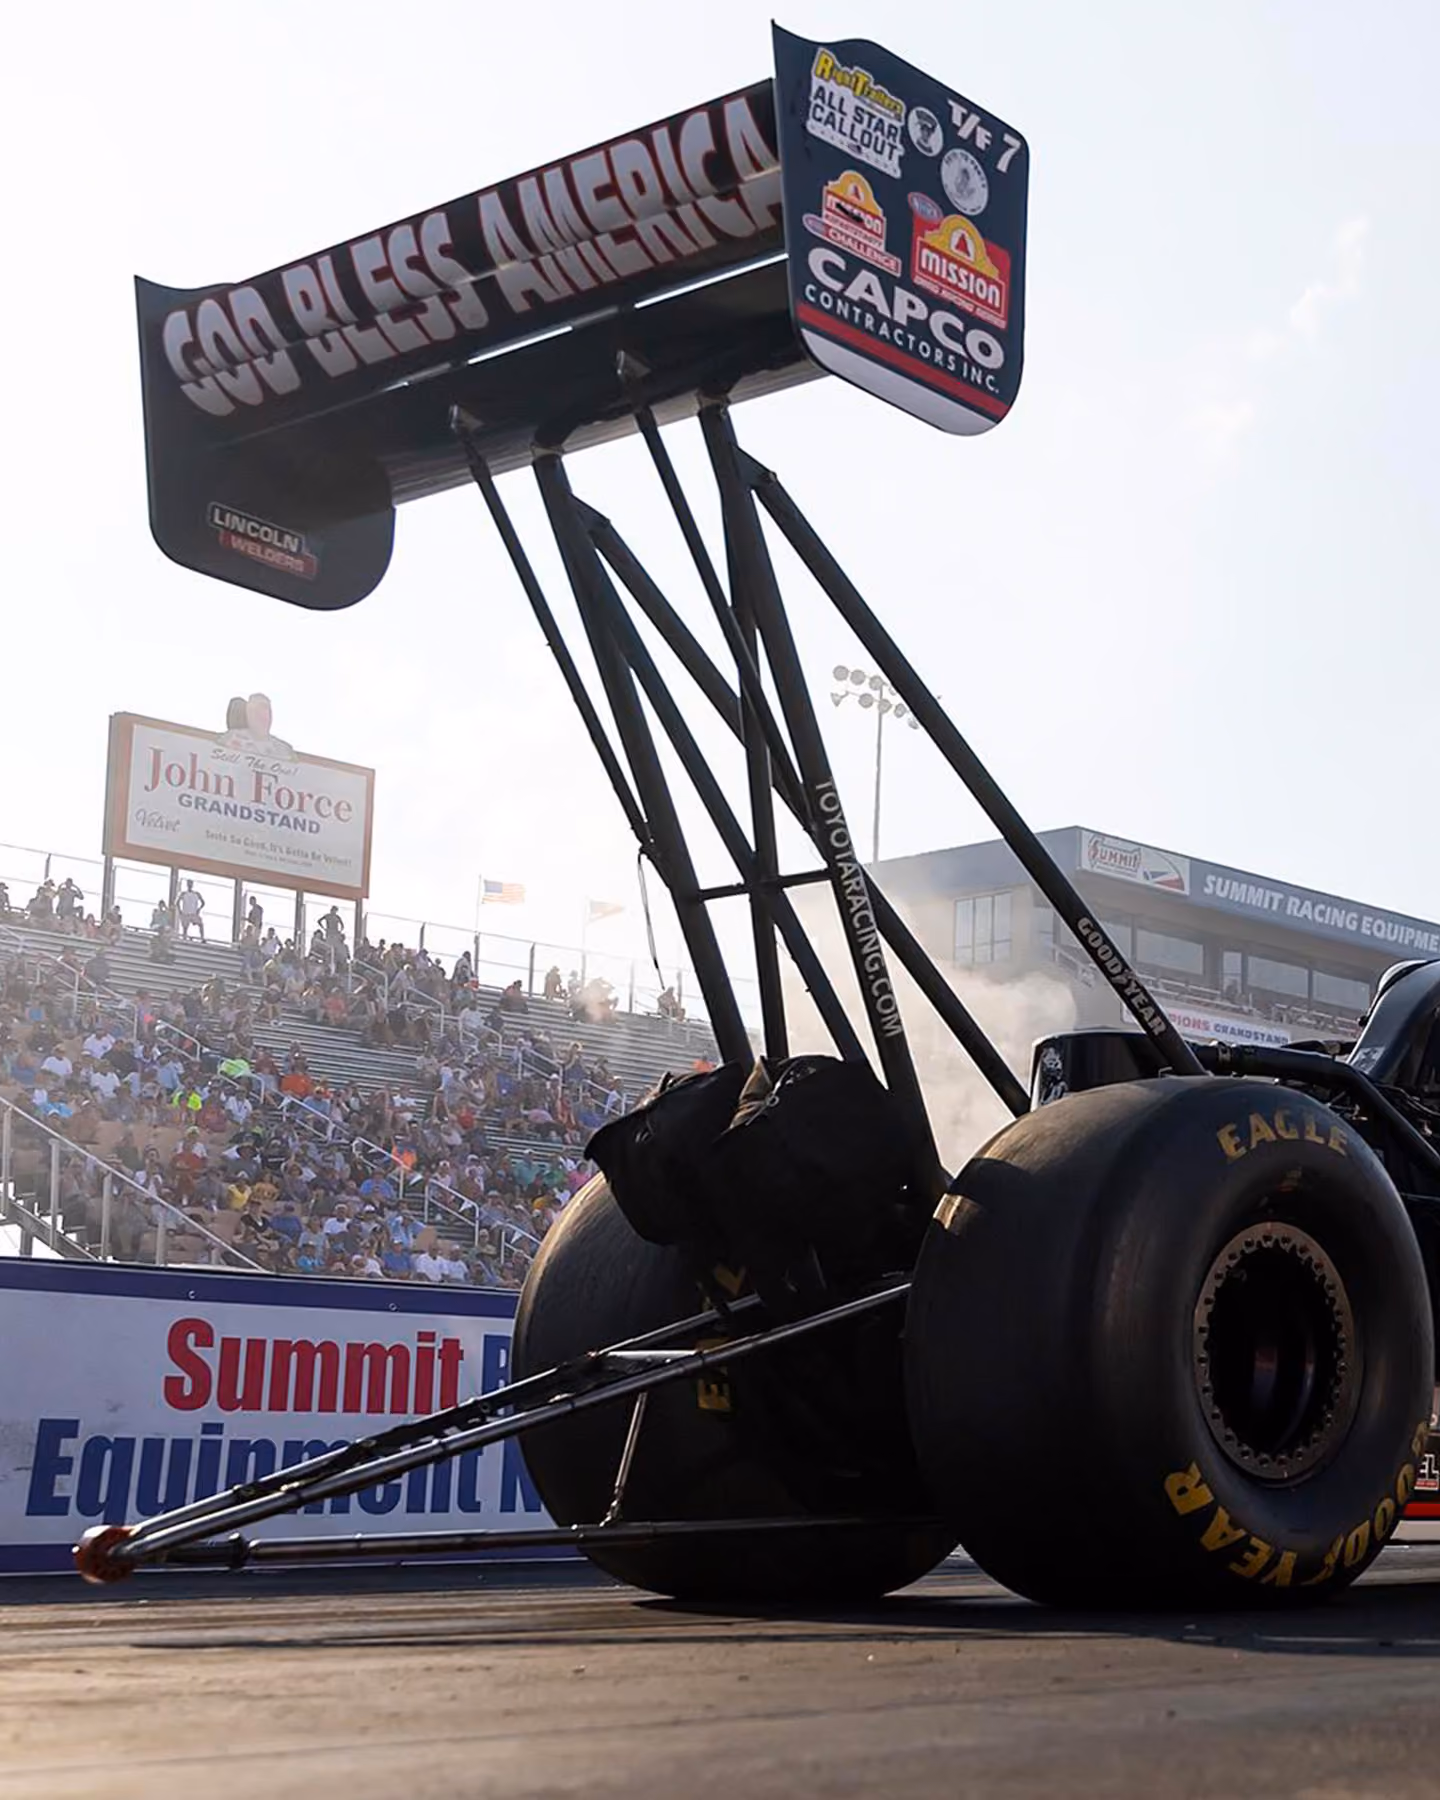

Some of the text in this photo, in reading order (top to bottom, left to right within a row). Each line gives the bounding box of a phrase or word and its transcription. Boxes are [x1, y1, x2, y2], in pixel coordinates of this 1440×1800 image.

[811, 103, 899, 161] CALLOUT
[813, 86, 848, 117] ALL
[852, 105, 899, 144] STAR
[996, 133, 1021, 173] 7
[163, 97, 787, 415] GOD BLESS AMERICA
[804, 284, 956, 377] CONTRACTORS
[808, 246, 1005, 372] CAPCO
[213, 508, 299, 553] LINCOLN
[230, 534, 305, 573] WELDERS
[144, 746, 353, 823] John Force
[178, 793, 321, 835] GRANDSTAND
[1203, 874, 1284, 912] SUMMIT
[1285, 895, 1359, 932] RACING
[1213, 1022, 1290, 1045] GRANDSTAND
[1216, 1109, 1349, 1162] EAGLE
[163, 1317, 465, 1415] Summit
